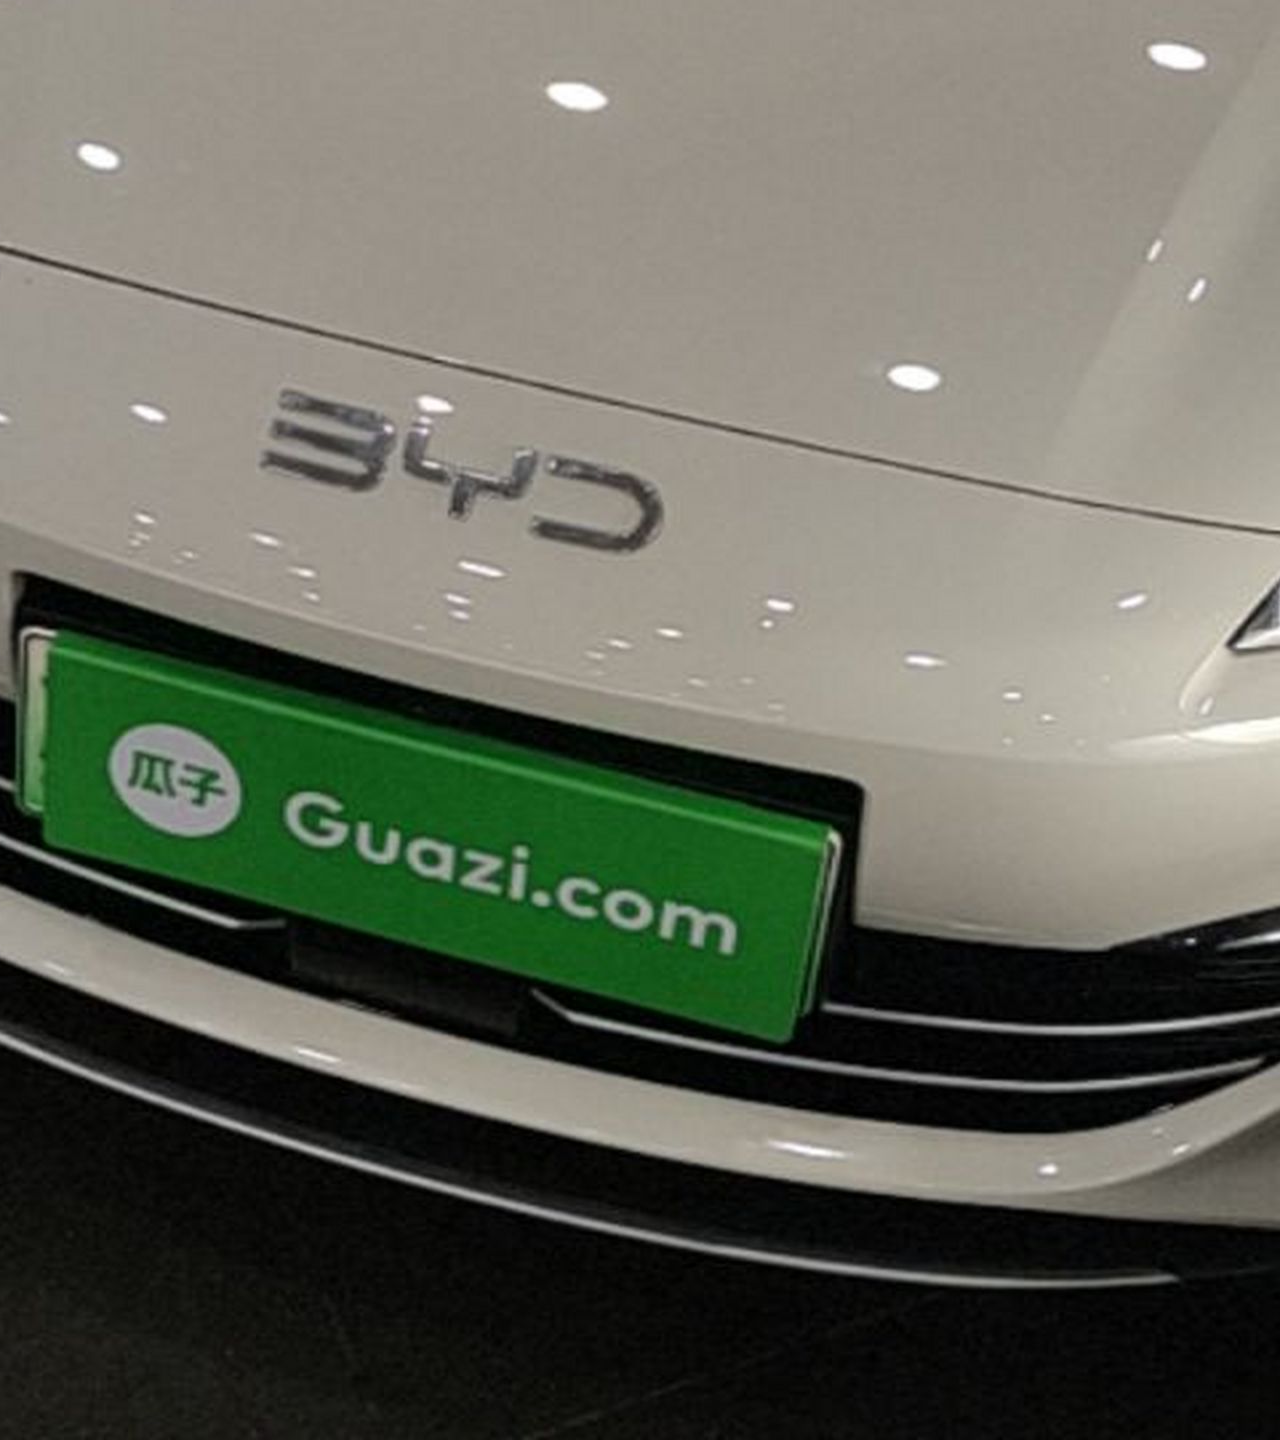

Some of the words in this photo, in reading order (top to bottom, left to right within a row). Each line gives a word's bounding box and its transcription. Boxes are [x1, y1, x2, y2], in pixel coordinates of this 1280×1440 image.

[261, 388, 664, 552] BYD
[128, 750, 226, 807] 瓜子
[284, 791, 738, 955] Guazi.com
